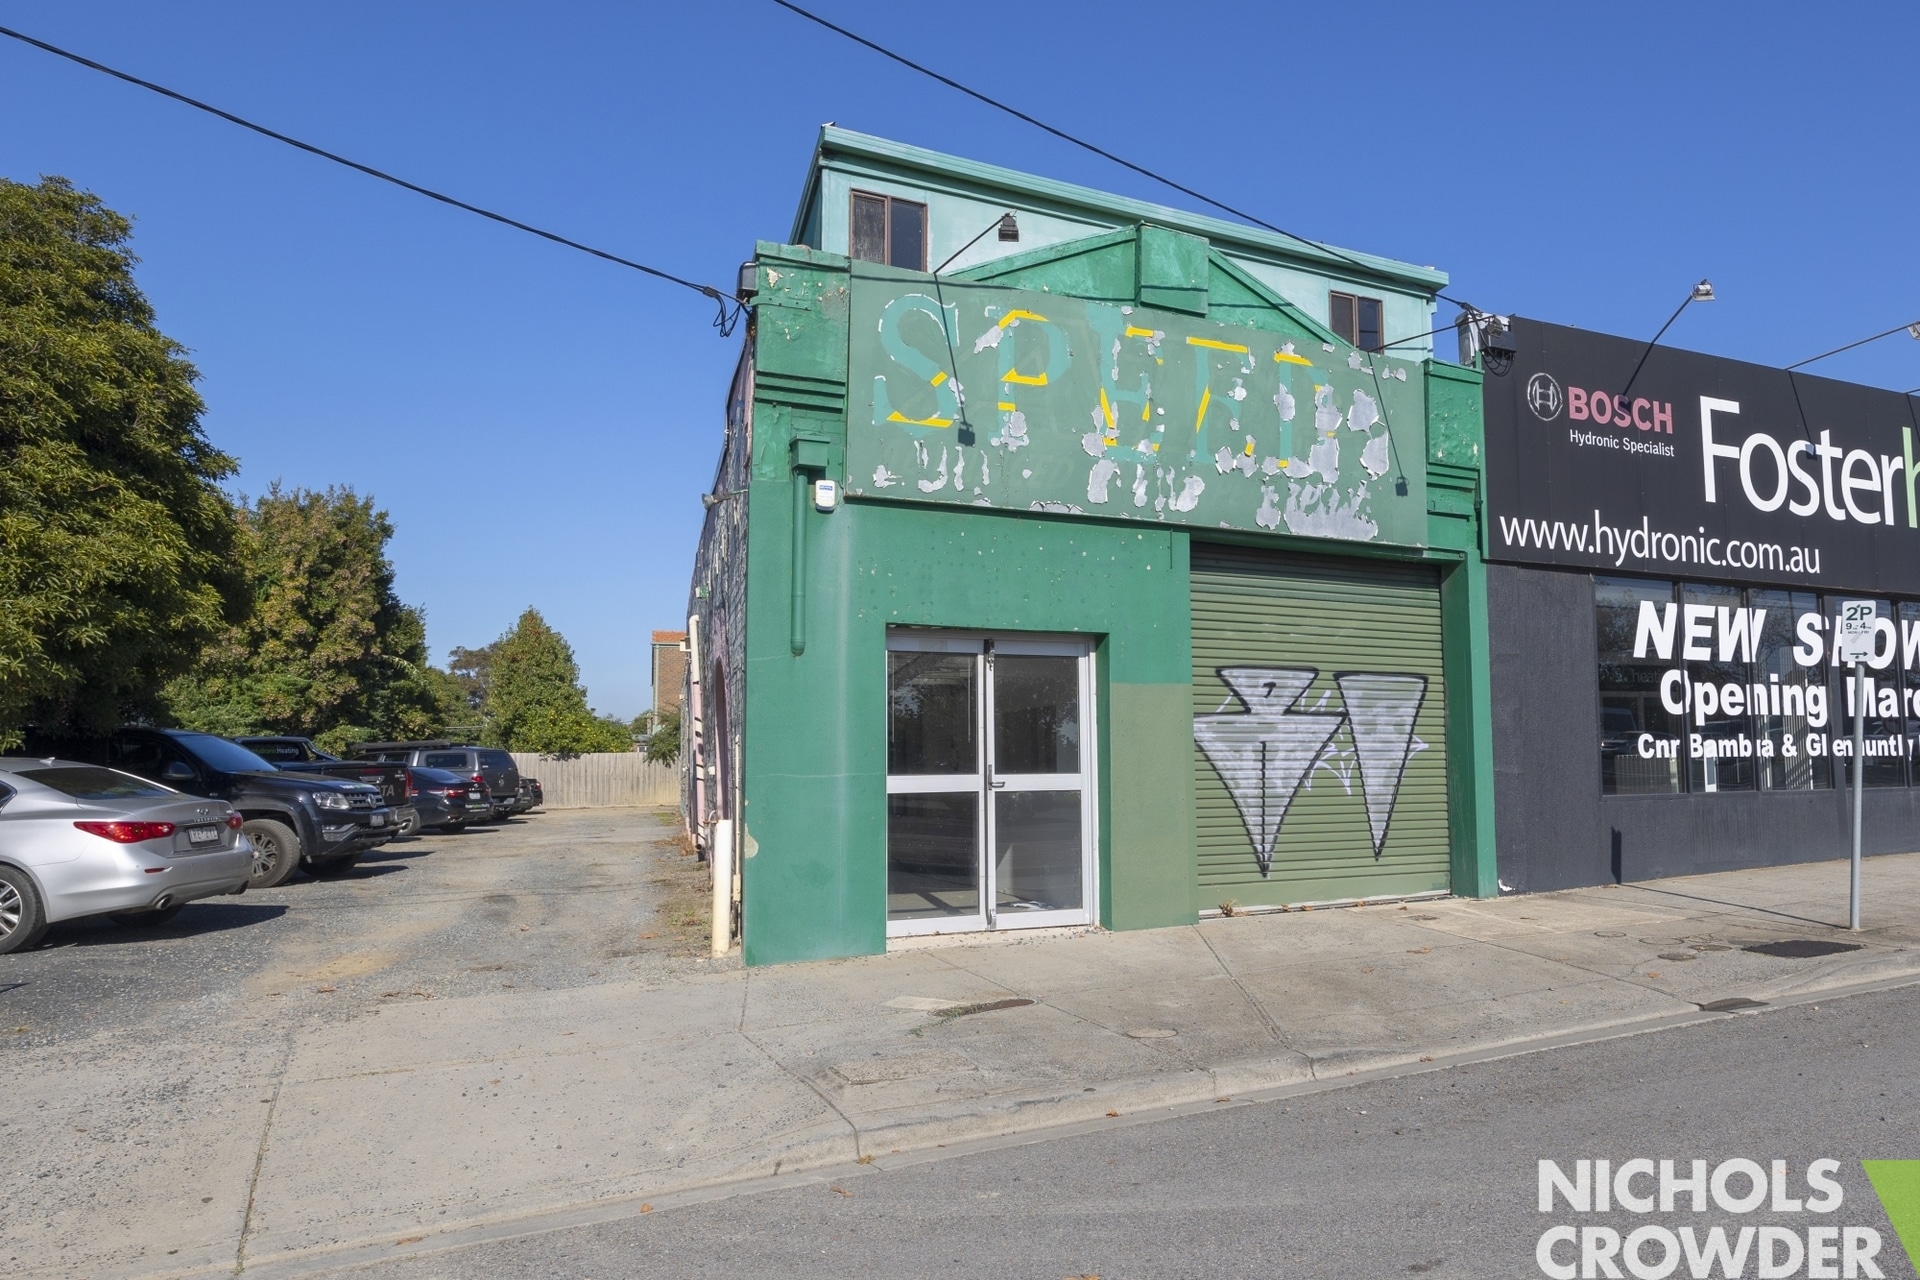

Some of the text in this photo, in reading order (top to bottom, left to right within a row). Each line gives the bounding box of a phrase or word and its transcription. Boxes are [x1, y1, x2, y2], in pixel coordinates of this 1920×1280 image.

[1568, 386, 1673, 434] BOSCH
[1570, 429, 1675, 457] Hydronic Specialist
[1499, 510, 1821, 574] www.hydronic.com.au
[1633, 600, 1767, 663] NEW
[1846, 606, 1872, 620] 2P
[1660, 669, 1828, 728] Opening
[1637, 733, 1680, 759] Cnr
[1781, 734, 1798, 757] &
